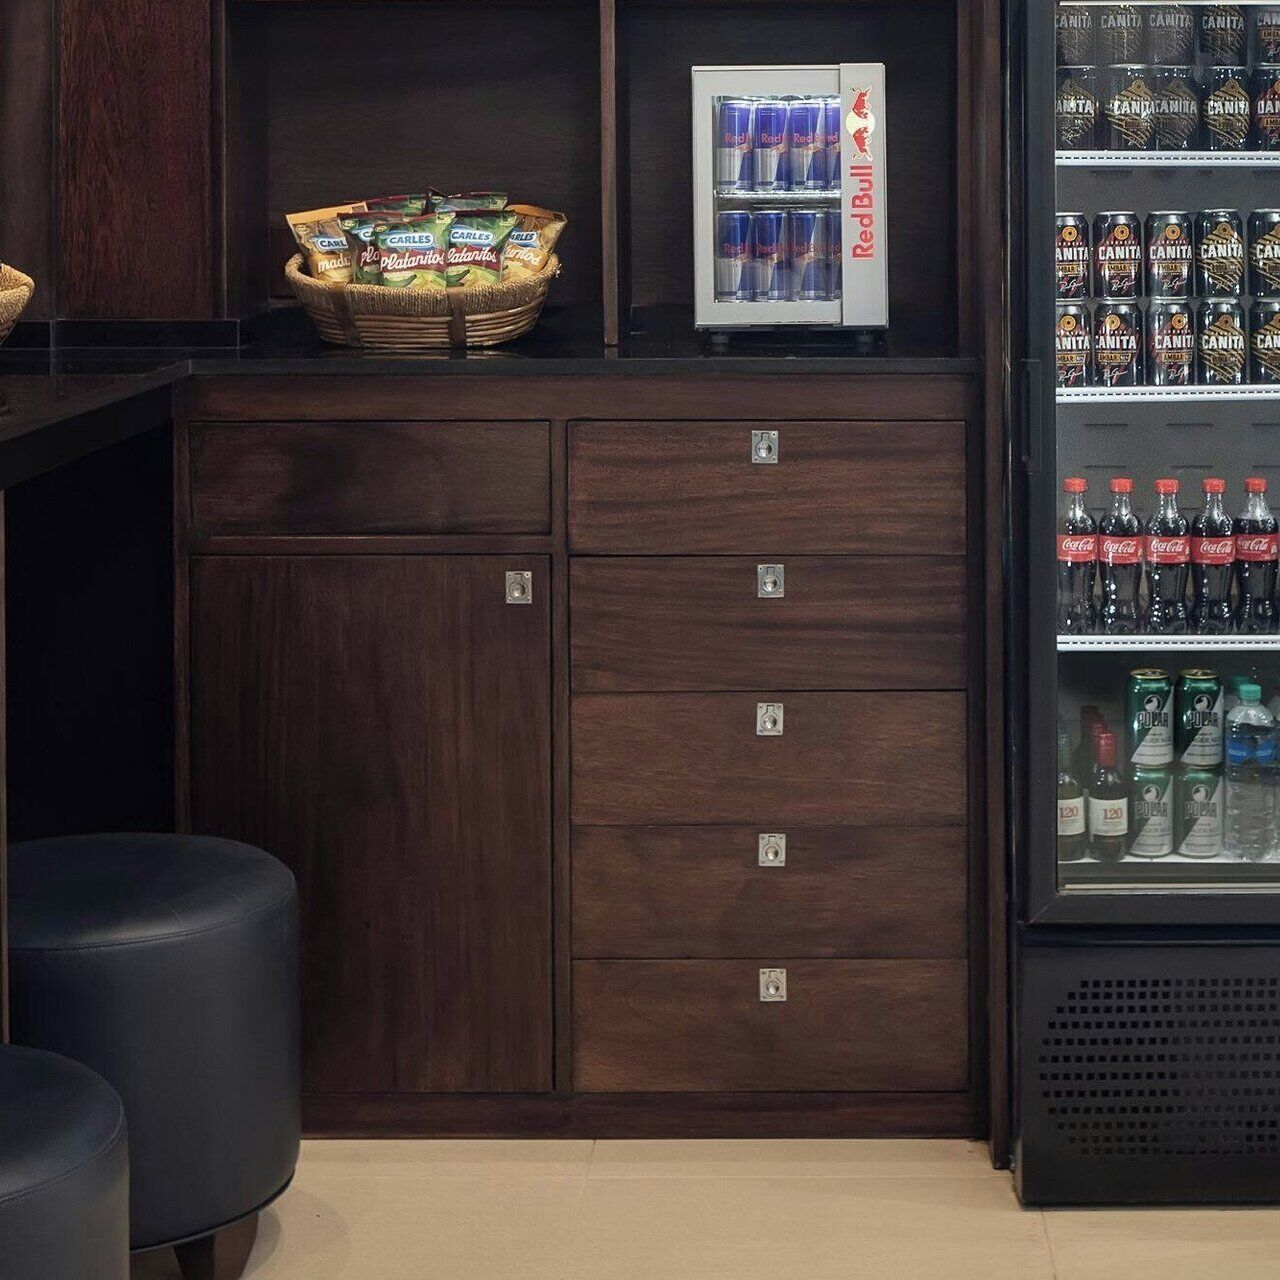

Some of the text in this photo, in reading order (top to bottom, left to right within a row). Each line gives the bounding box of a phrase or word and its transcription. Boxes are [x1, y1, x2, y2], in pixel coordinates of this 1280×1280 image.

[1056, 99, 1094, 113] ANITA
[849, 164, 874, 261] Red Bull
[389, 233, 431, 245] CARLES
[451, 231, 491, 241] CARLES
[511, 232, 535, 242] ARLES
[320, 239, 347, 248] CARL
[447, 245, 497, 263] latanitos
[1055, 246, 1090, 261] ANITA
[1098, 246, 1141, 260] CANITA
[1149, 246, 1193, 260] CANITA
[1200, 244, 1244, 259] CANITA
[1055, 336, 1091, 350] ANITA
[1201, 335, 1245, 349] CANITA
[1137, 711, 1169, 728] POLAR
[1187, 711, 1219, 729] POLAR
[1135, 801, 1168, 819] POLAR
[1184, 801, 1218, 819] POLAR
